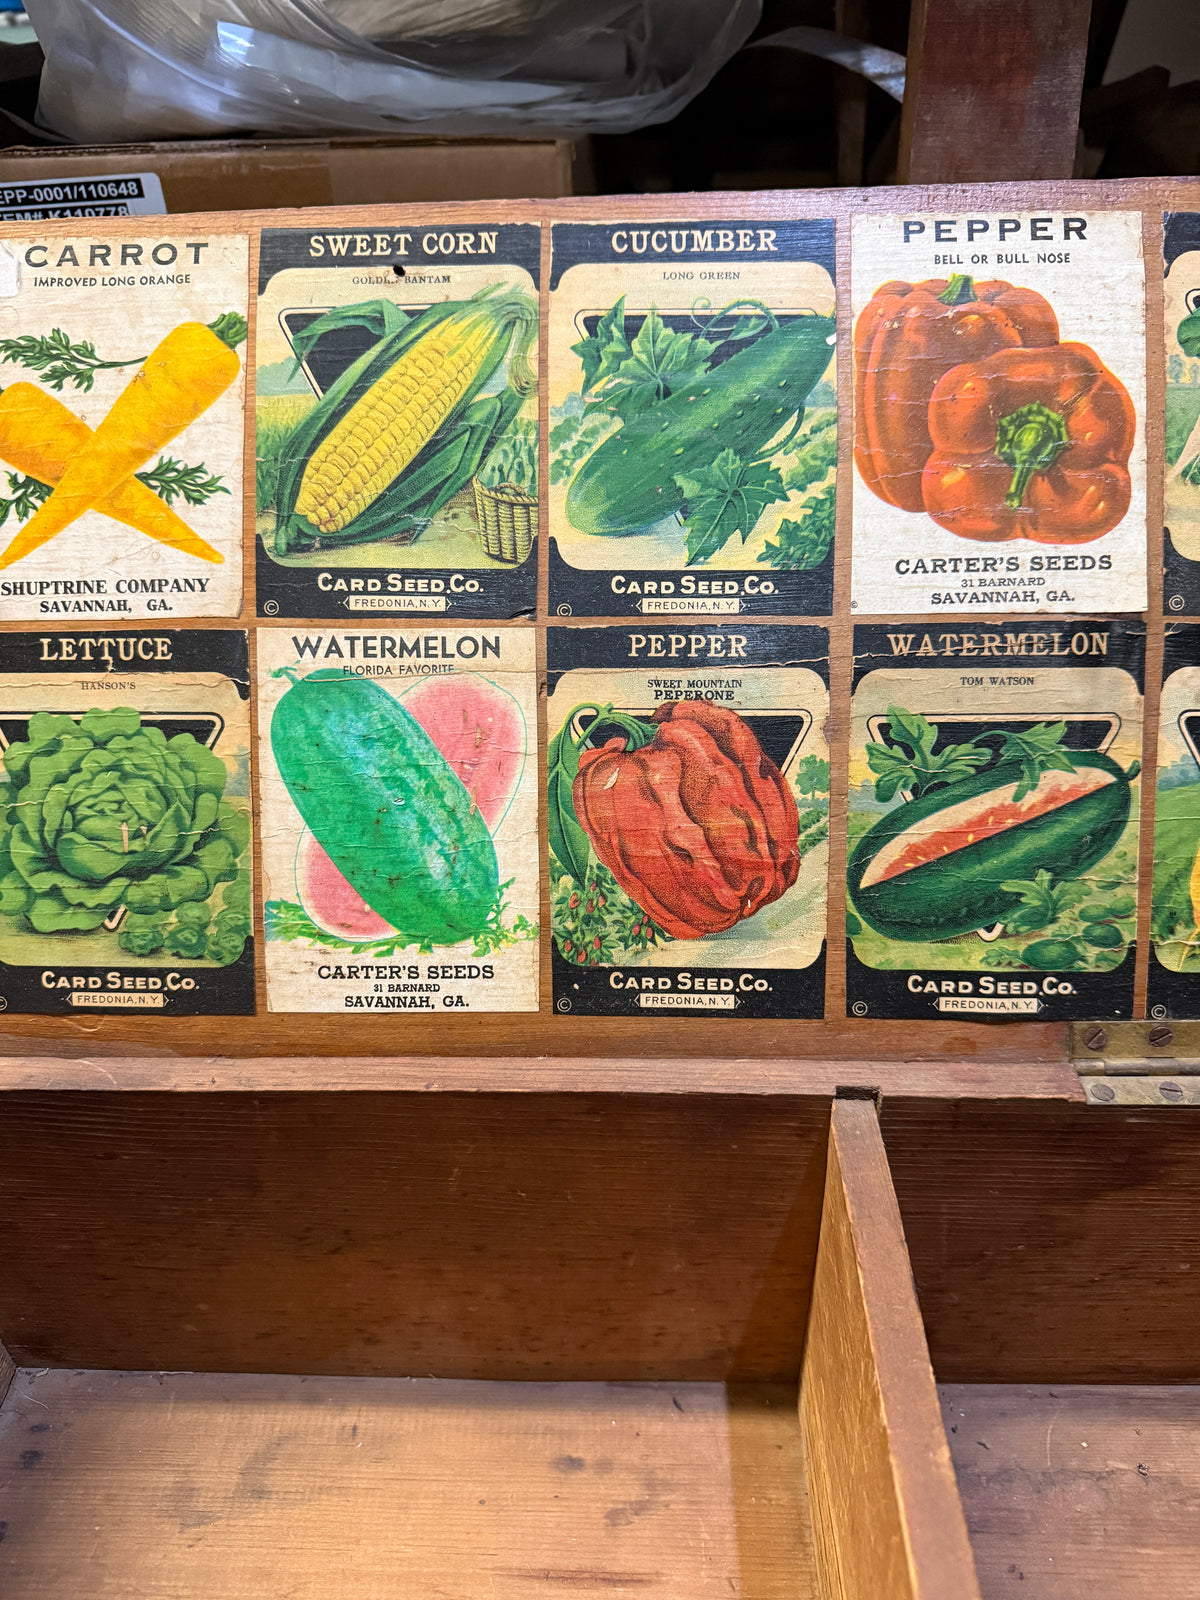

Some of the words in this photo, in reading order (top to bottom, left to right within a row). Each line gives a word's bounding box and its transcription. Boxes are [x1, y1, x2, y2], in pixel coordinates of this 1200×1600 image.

[903, 217, 1087, 243] PEPPER
[309, 233, 412, 257] SWEET
[422, 231, 498, 255] CORN
[611, 229, 778, 254] CUCUMBER
[24, 242, 209, 267] CARROT
[934, 254, 963, 265] BELL
[971, 254, 988, 265] OR
[997, 253, 1029, 264] BULL
[1037, 252, 1071, 264] NOSE
[33, 277, 97, 288] IMPROVED
[101, 276, 136, 287] LONG
[139, 274, 191, 286] ORANGE
[404, 275, 451, 284] BANTAM
[662, 271, 694, 281] LONG
[699, 271, 741, 281] GREEN
[895, 557, 1019, 574] CARTER'S
[1029, 554, 1113, 571] SEEDS
[1, 580, 107, 596] SHUPTRINE
[115, 578, 210, 593] COMPANY
[978, 577, 1045, 587] BARNARD
[931, 591, 1040, 605] SAVANNAH,
[1045, 591, 1075, 603] GA.
[39, 600, 133, 613] SAVANNAH,
[146, 599, 173, 611] GA.
[39, 638, 173, 661] LETTUCE
[291, 636, 501, 659] WATERMELON
[627, 634, 748, 657] PEPPER
[887, 633, 1109, 656] WATERMELON
[343, 665, 393, 675] FLORIDA
[399, 664, 454, 674] FAVORITE
[81, 681, 136, 691] HANSON'S
[647, 679, 682, 688] SWEET
[687, 680, 742, 689] MOUNTAIN
[960, 676, 984, 686] TOM
[989, 676, 1034, 686] WATSON
[653, 690, 735, 700] PEPERONE
[317, 965, 420, 980] CARTER'S
[427, 965, 494, 979] SEEDS
[374, 984, 383, 992] 31
[388, 983, 440, 992] BARNARD
[344, 995, 436, 1009] SAVANNAH,
[443, 995, 470, 1007] GA.
